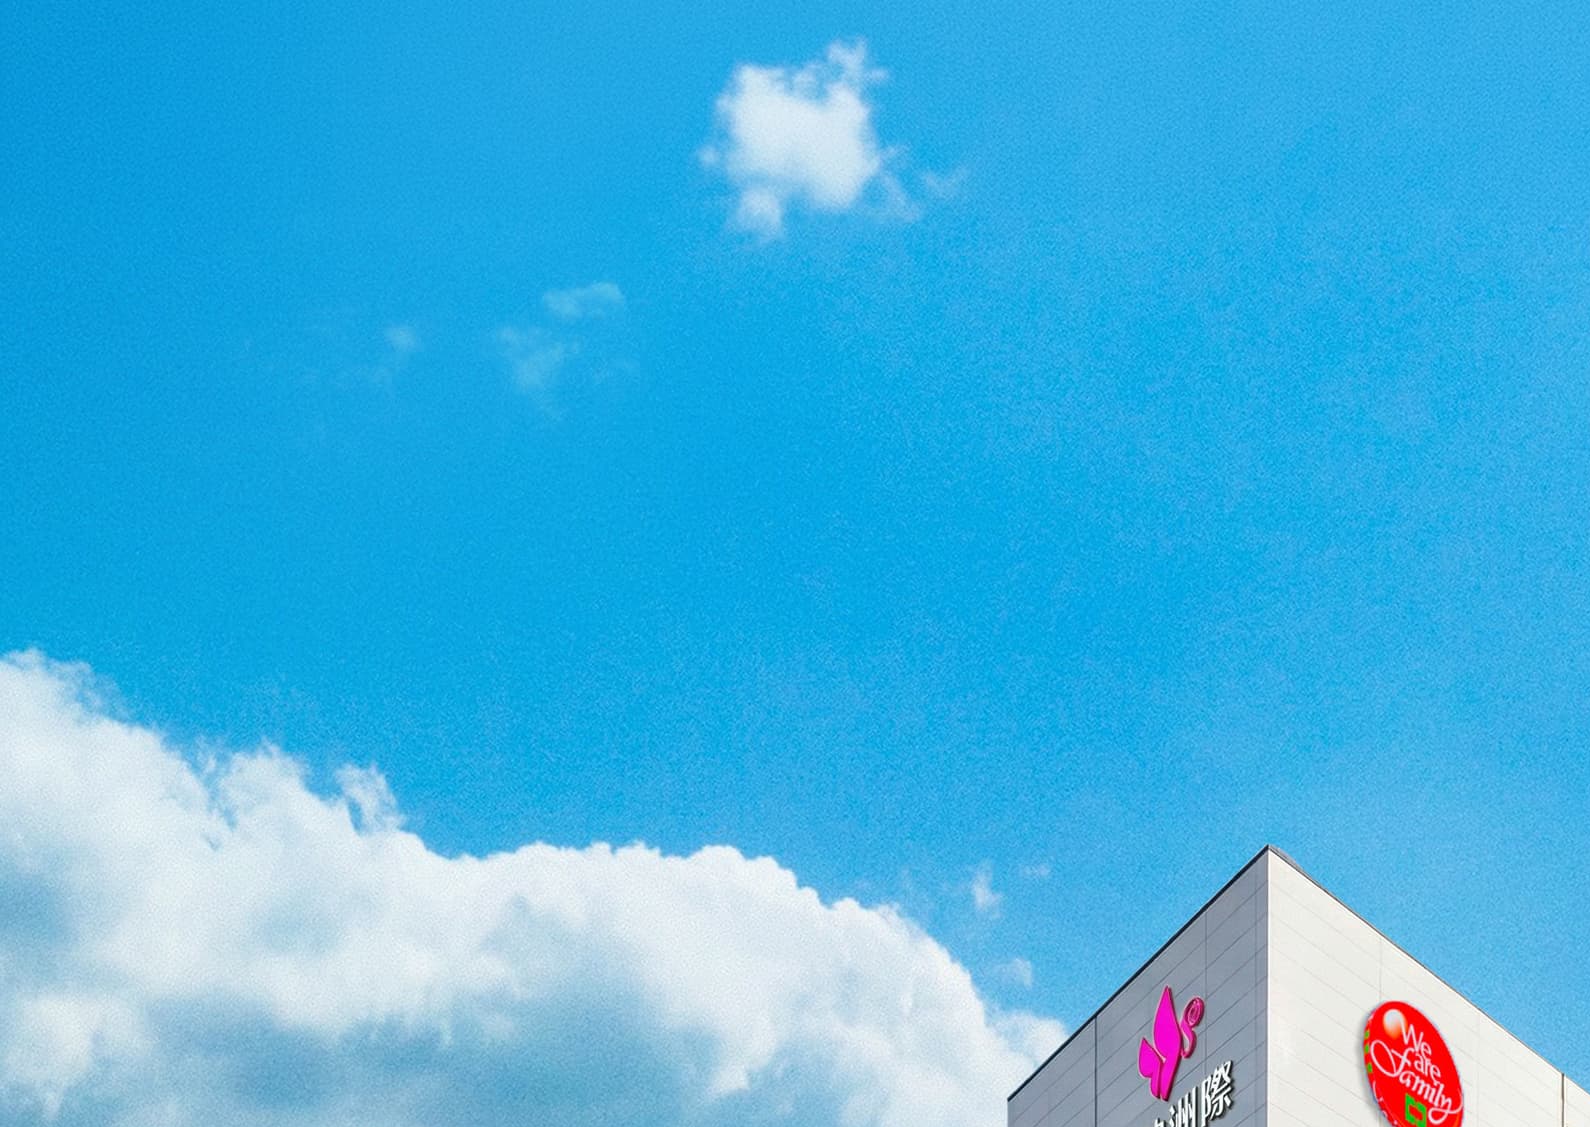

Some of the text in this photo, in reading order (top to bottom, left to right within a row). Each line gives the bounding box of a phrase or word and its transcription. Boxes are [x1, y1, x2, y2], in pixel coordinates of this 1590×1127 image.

[1400, 1017, 1432, 1057] We
[1370, 1040, 1463, 1125] Family
[1414, 1053, 1441, 1083] are
